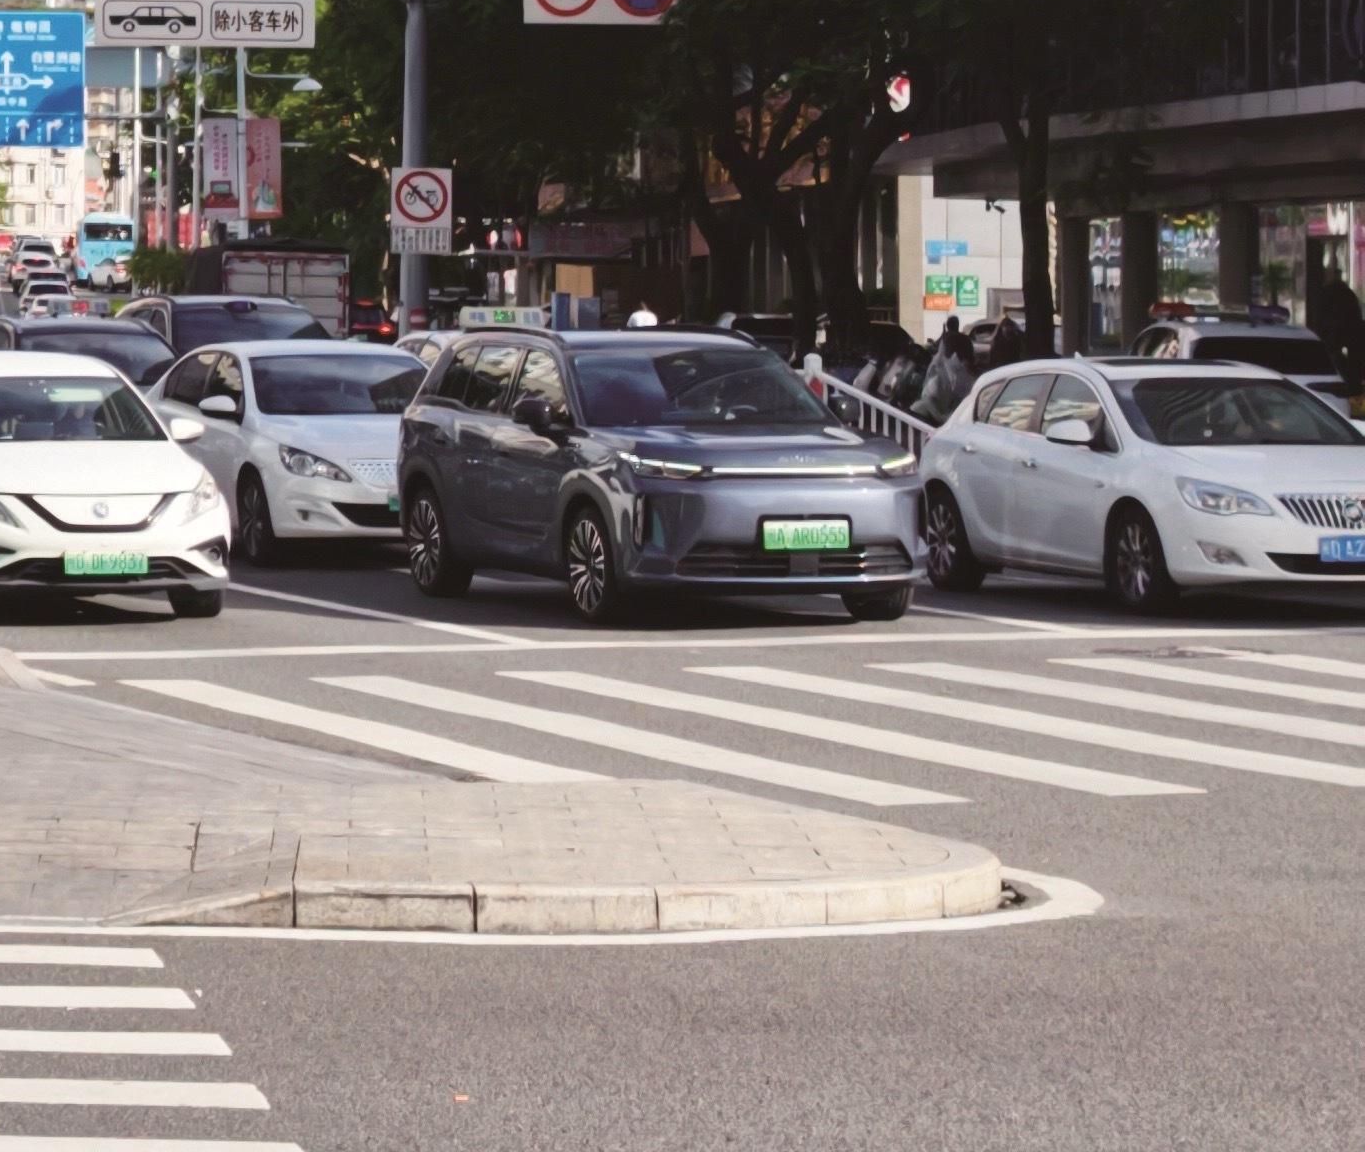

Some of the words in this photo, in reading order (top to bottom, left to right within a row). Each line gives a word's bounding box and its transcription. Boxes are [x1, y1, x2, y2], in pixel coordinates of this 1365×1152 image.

[213, 9, 299, 33] 除小客车外
